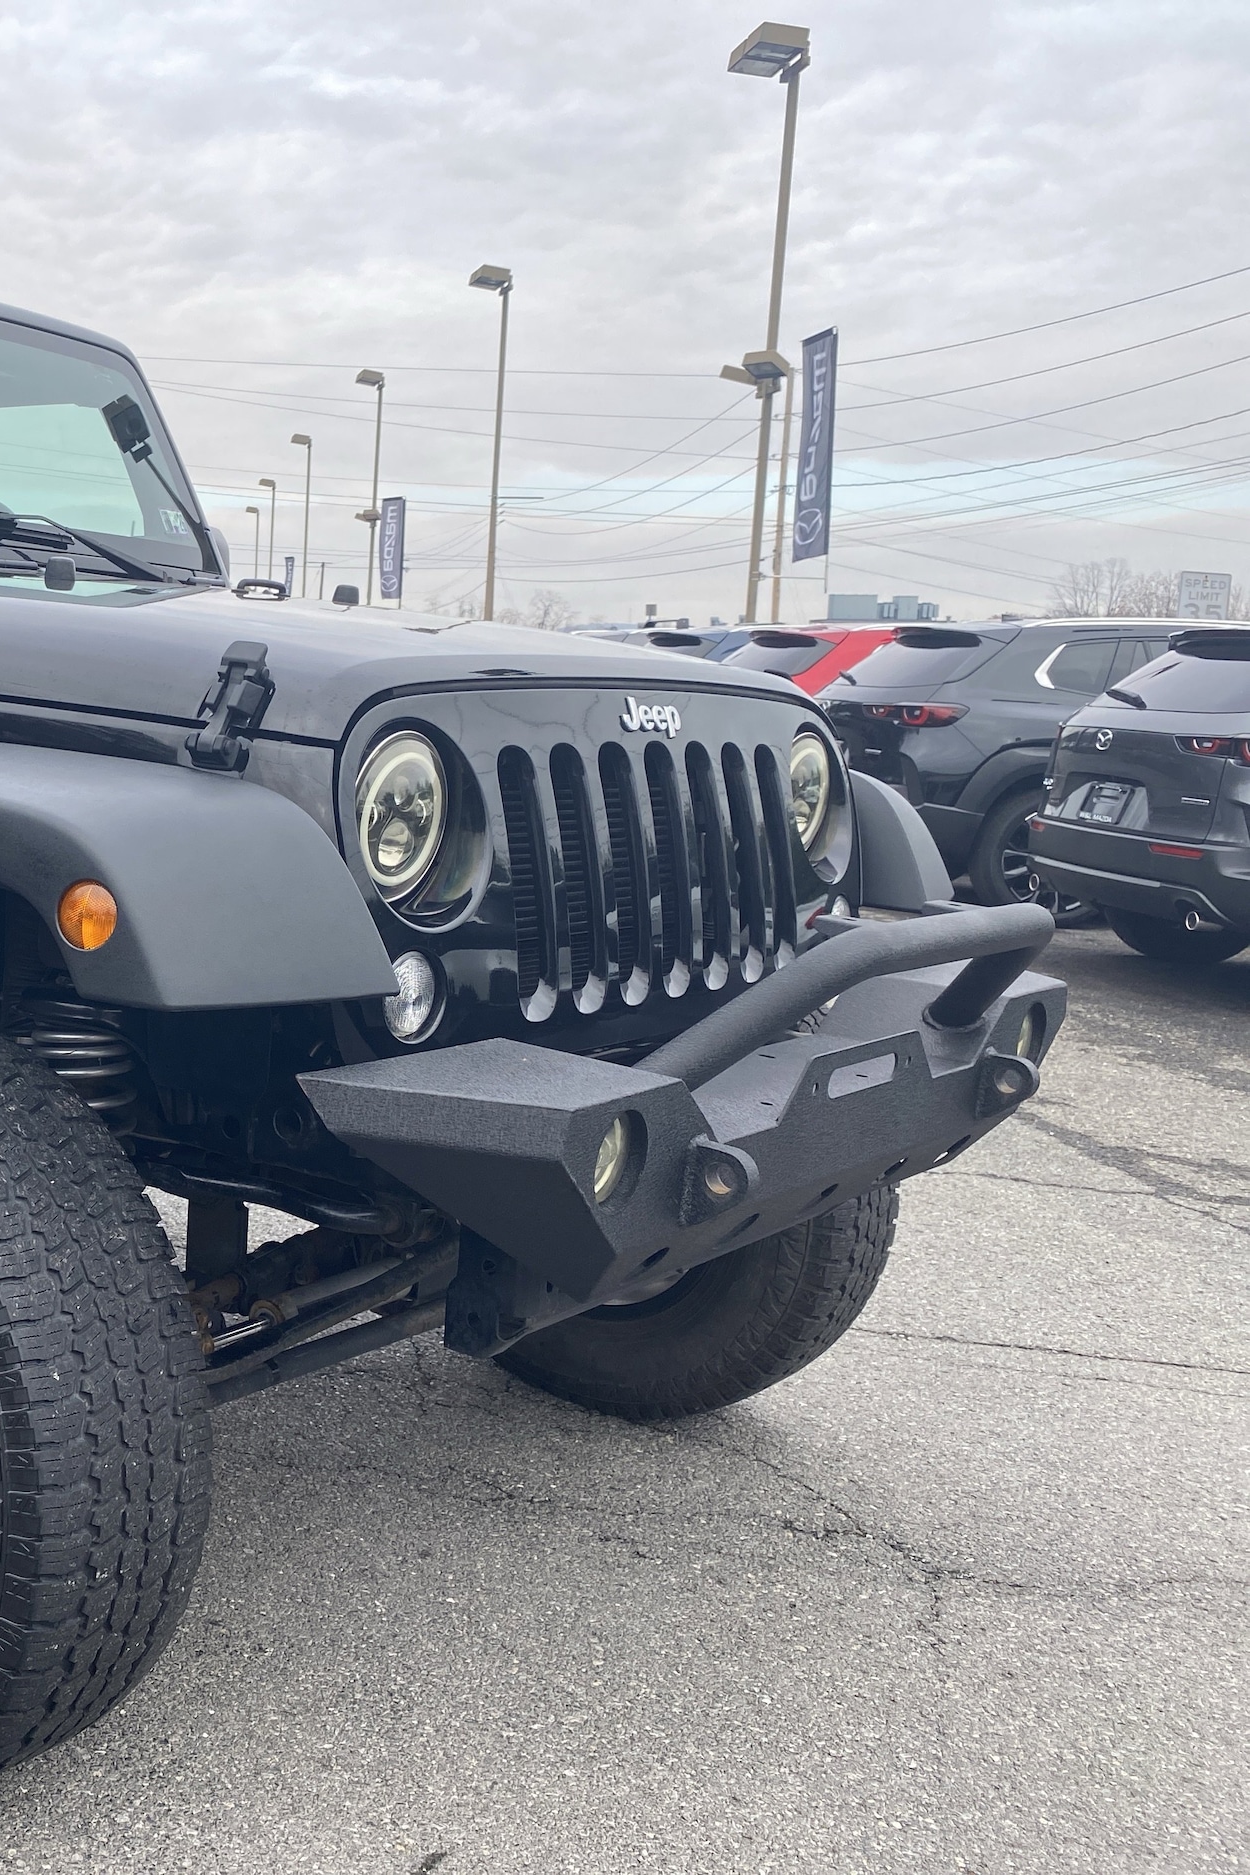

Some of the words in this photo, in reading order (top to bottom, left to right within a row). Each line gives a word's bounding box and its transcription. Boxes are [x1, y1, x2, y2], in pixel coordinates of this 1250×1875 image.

[1184, 578, 1227, 590] SPEED
[1188, 591, 1222, 602] LIMIT
[1183, 603, 1223, 620] 35
[620, 696, 681, 739] Jeep
